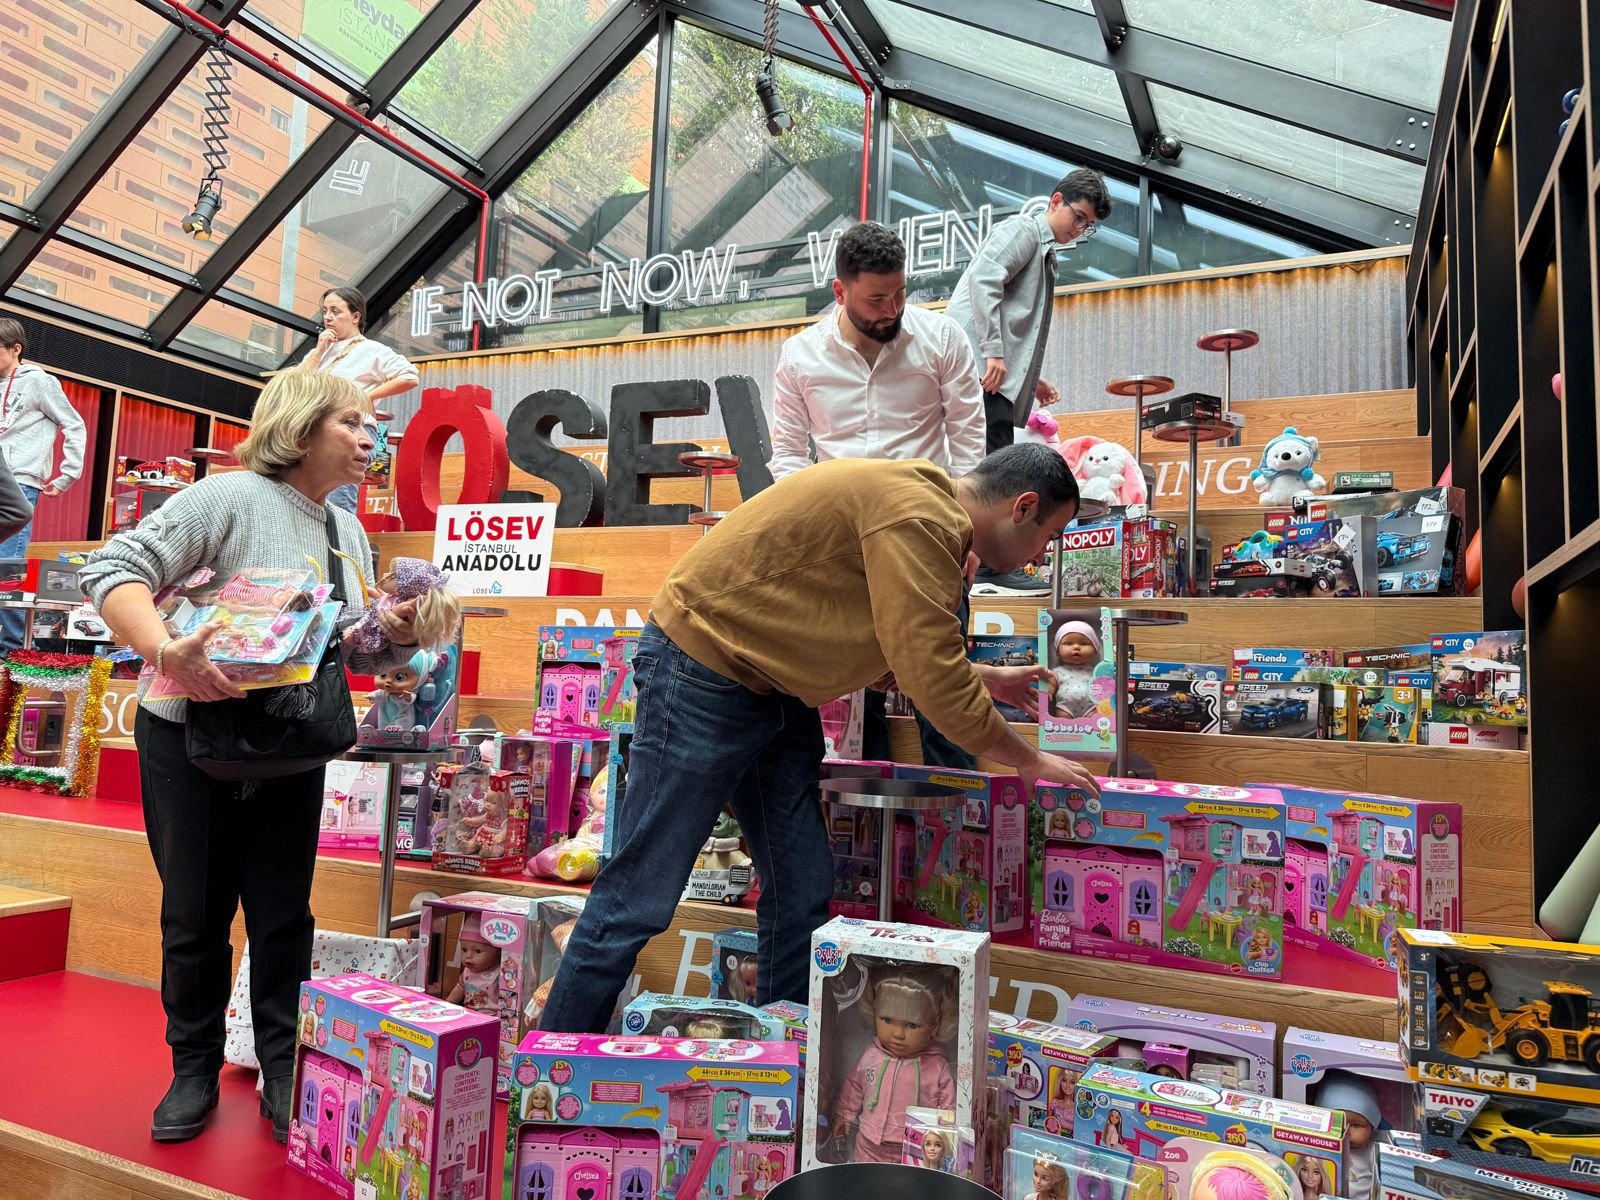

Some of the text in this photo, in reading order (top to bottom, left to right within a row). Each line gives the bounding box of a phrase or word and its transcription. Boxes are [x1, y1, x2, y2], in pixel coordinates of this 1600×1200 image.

[411, 286, 443, 336] IF
[462, 268, 563, 330] NOT
[600, 243, 750, 313] NOW,
[1312, 508, 1326, 518] LEGO
[447, 510, 545, 542] LÖSEV
[1268, 518, 1285, 527] LEGO
[1299, 527, 1314, 536] CITY
[1046, 530, 1114, 551] NOPOLY
[464, 541, 518, 553] İSTANBUL
[441, 554, 542, 572] ANADOLU
[975, 641, 1016, 649] TECHNIC
[1444, 638, 1460, 647] CITY
[1253, 652, 1288, 663] Friends
[1348, 651, 1412, 664] LEGO TECHNIC
[1244, 671, 1283, 681] LEGO CITY
[1412, 677, 1429, 685] CITY
[1138, 681, 1170, 689] SPEED
[1237, 683, 1269, 692] SPEED
[1450, 731, 1468, 739] LEGO
[695, 889, 722, 898] THE CHILD
[1041, 909, 1069, 924] Barbie
[484, 921, 517, 938] BABY
[1039, 923, 1071, 935] Family
[493, 933, 507, 941] born
[1051, 932, 1060, 941] &
[1038, 937, 1072, 950] Friends
[820, 955, 838, 967] More
[1247, 965, 1275, 973] Chelsea
[786, 1028, 793, 1039] 4
[1043, 1048, 1068, 1059] GETAWAY
[525, 1056, 531, 1065] 5
[1428, 1092, 1476, 1109] TAIYO
[1140, 1101, 1151, 1117] 4
[1224, 1132, 1247, 1144] 360
[1275, 1130, 1310, 1143] GETAWAY
[1164, 1151, 1180, 1160] Zoe
[1386, 1145, 1433, 1160] TAIYO
[288, 1149, 306, 1169] Friends
[573, 1170, 600, 1181] Chelsea
[1476, 1168, 1566, 1197] McLaren
